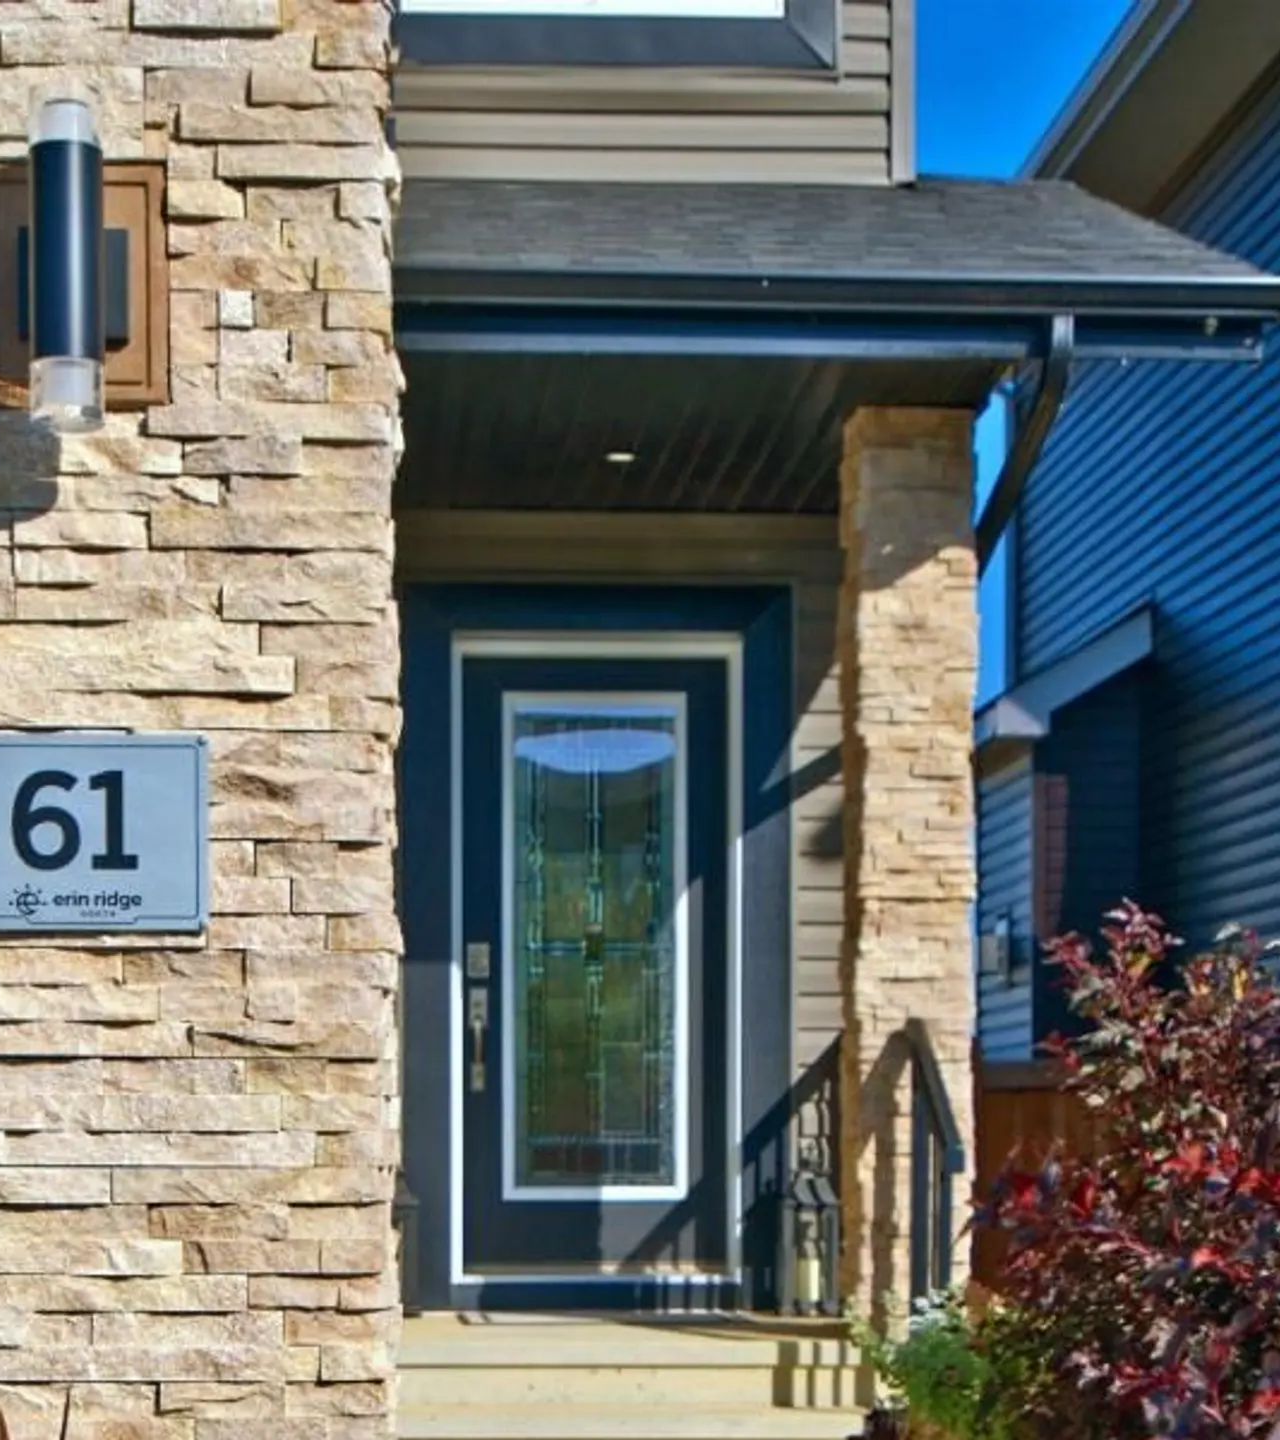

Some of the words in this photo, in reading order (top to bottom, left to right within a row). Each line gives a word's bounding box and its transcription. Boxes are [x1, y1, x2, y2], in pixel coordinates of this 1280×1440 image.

[11, 769, 139, 872] 61
[52, 890, 90, 906] erin
[93, 890, 142, 911] ridge
